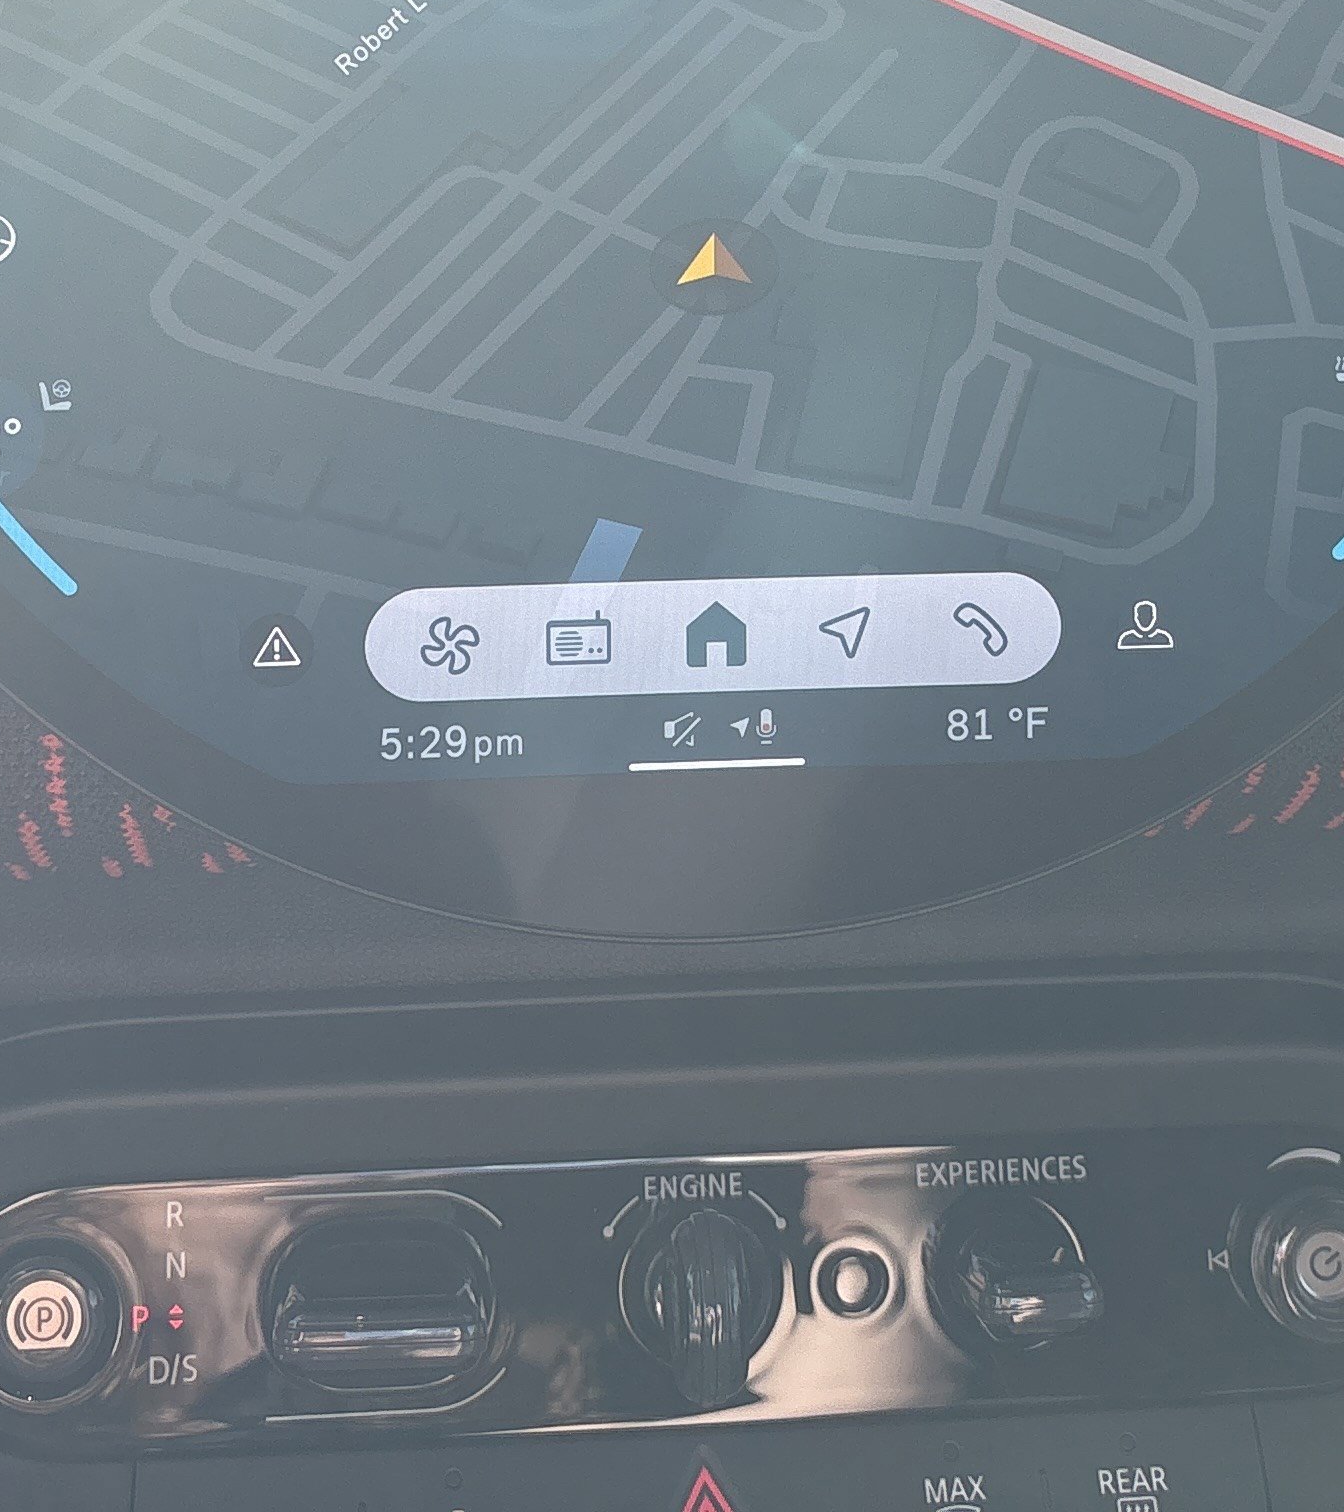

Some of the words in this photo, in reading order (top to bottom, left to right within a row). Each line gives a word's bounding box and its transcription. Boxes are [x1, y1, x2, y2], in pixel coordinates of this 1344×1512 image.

[333, 6, 409, 76] Robert
[947, 709, 993, 741] 81
[1009, 707, 1049, 739] °F
[916, 1155, 1087, 1188] EXPERIENCES
[644, 1172, 743, 1201] ENGINE
[166, 1201, 184, 1228] R
[166, 1251, 187, 1280] N
[37, 1306, 53, 1332] P
[131, 1305, 150, 1333] P
[149, 1353, 198, 1385] D/S
[924, 1475, 986, 1504] MAX
[1098, 1466, 1169, 1495] REAR
